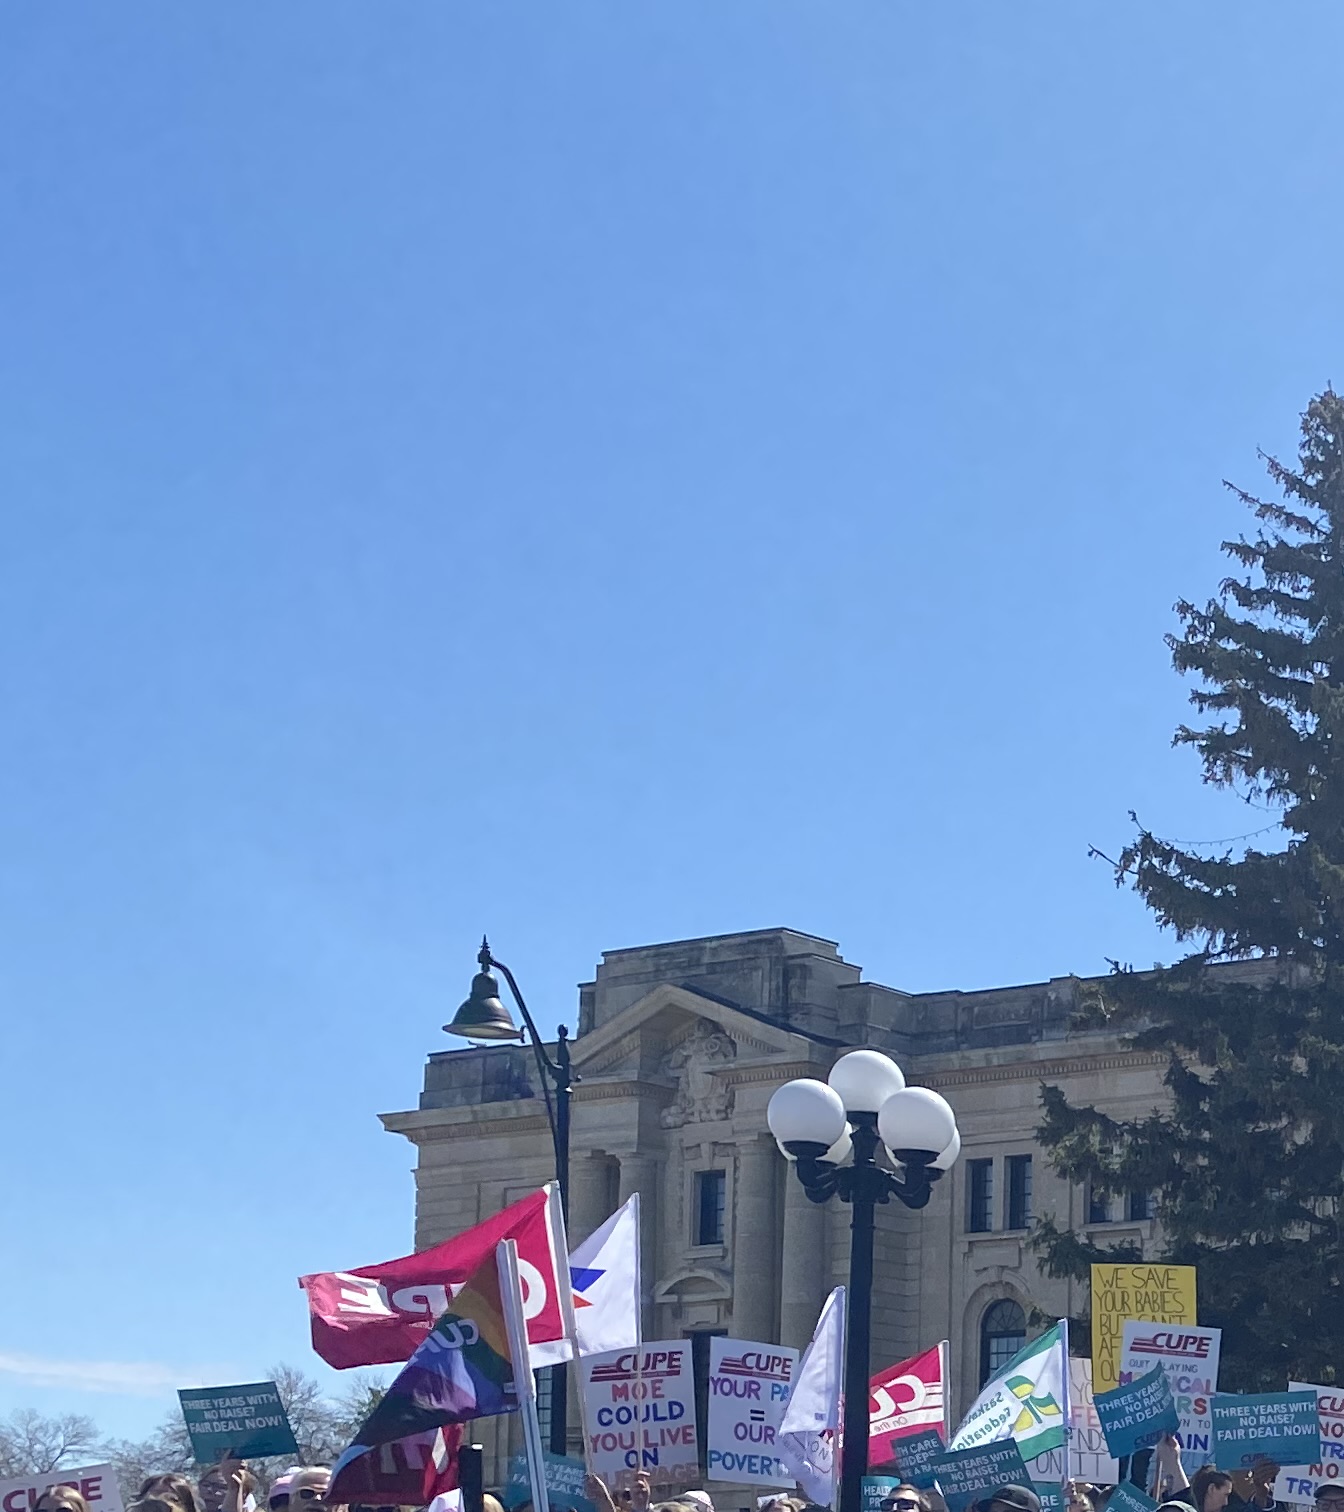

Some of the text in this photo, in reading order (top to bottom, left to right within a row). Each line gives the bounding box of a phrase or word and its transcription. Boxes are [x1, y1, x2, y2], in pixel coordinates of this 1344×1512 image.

[1097, 1267, 1179, 1291] WE SAVE
[1094, 1290, 1185, 1314] YOUR BABIES
[615, 1350, 683, 1373] CUPE
[740, 1352, 794, 1376] CUPE
[611, 1378, 665, 1403] MOE
[709, 1376, 762, 1401] YOUR
[597, 1400, 685, 1427] COULD
[1214, 1401, 1317, 1418] THREE YEARS WITH
[1240, 1413, 1295, 1426] NO RAISE?
[590, 1424, 696, 1454] YOU LIVE
[734, 1422, 775, 1445] OUR
[1217, 1423, 1316, 1441] FAIR DEAL NOW!
[624, 1447, 660, 1469] ON
